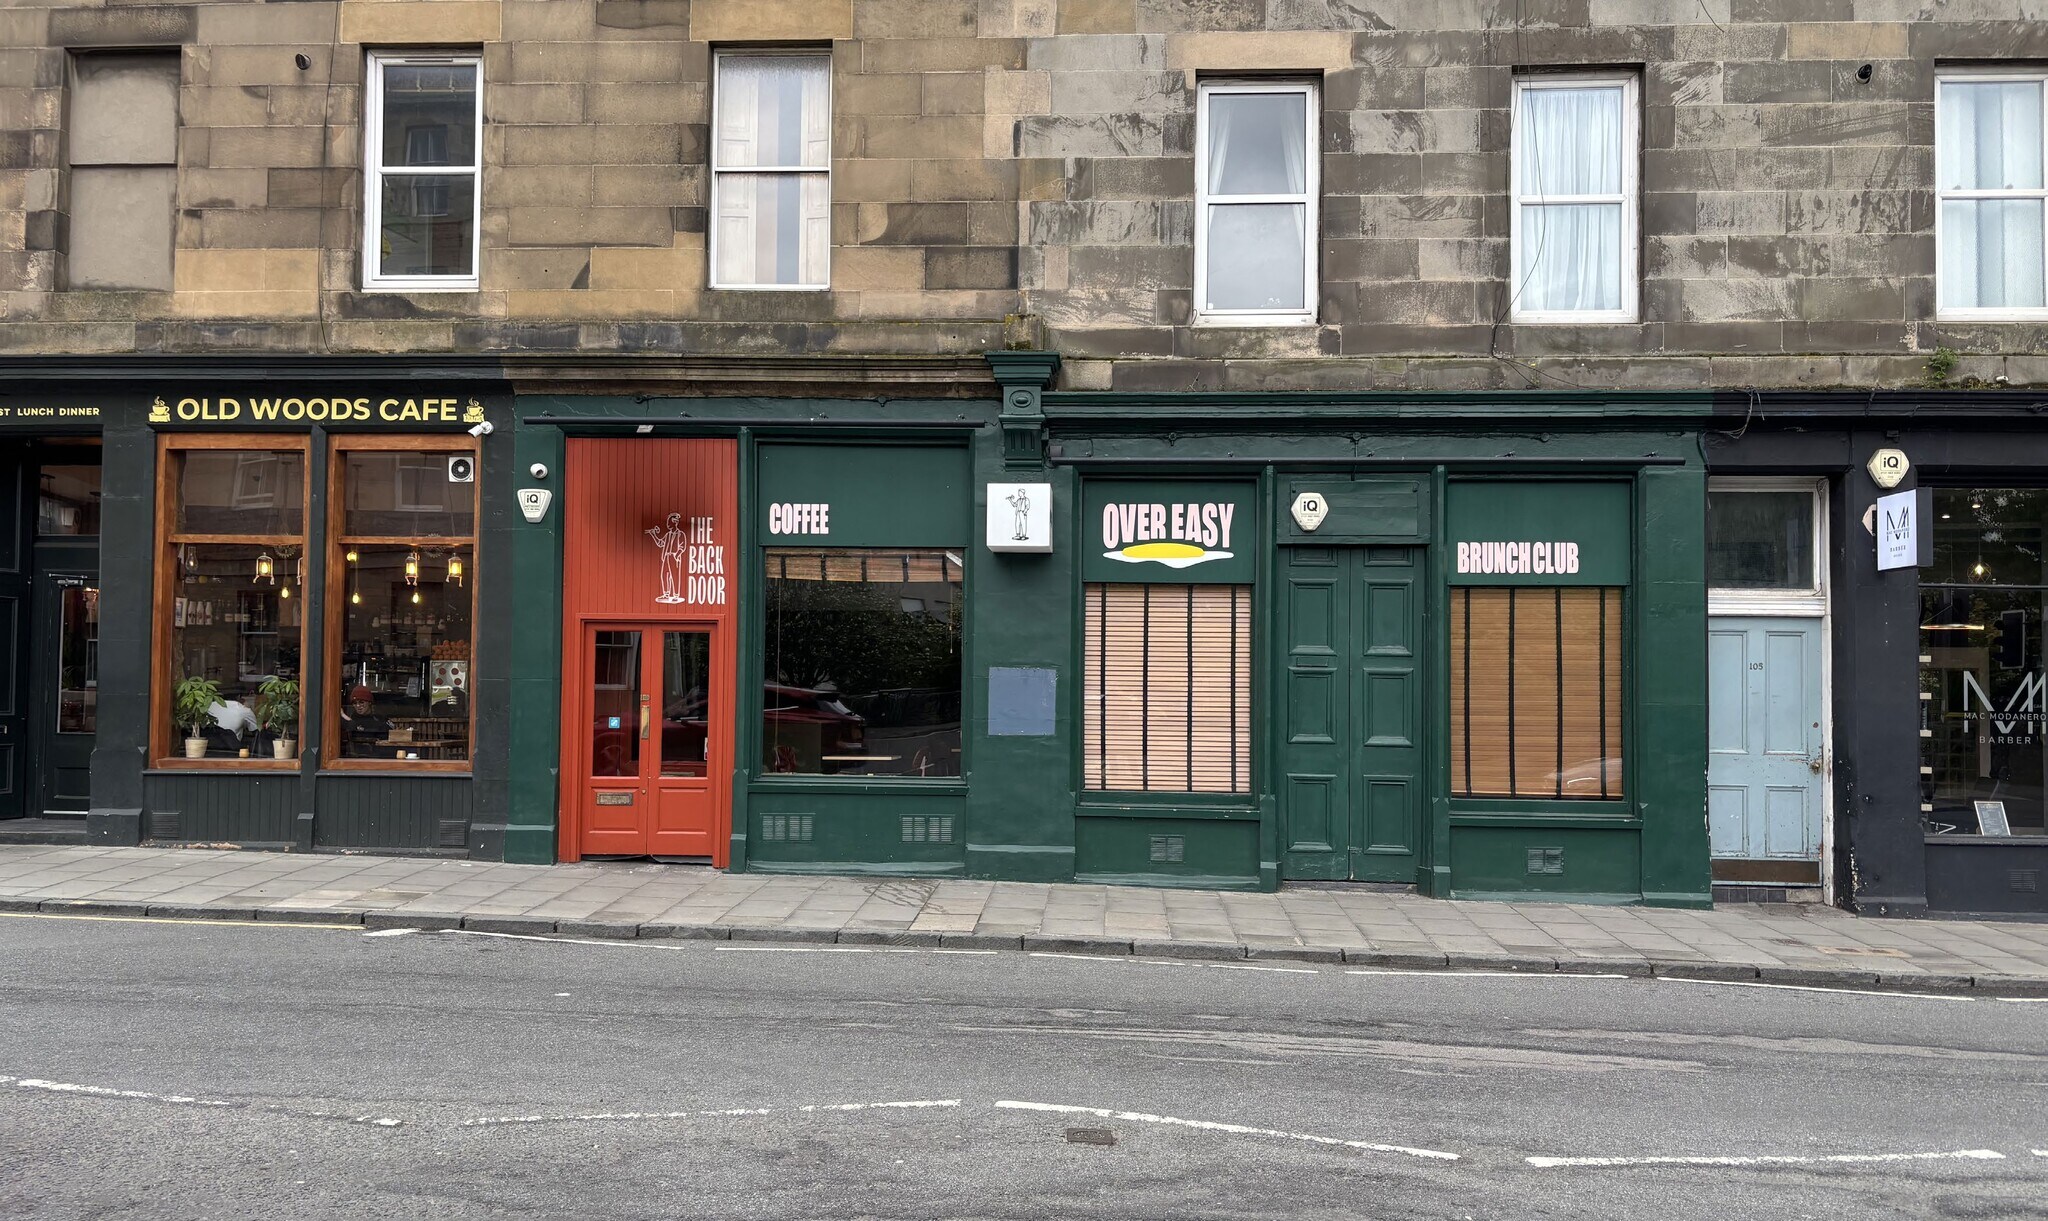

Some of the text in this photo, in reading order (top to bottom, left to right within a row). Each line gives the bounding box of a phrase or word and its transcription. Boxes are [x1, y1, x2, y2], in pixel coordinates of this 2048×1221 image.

[17, 408, 54, 416] LUNCH
[59, 408, 100, 416] DINNER
[177, 398, 458, 421] OLD WOODS CAFE
[1303, 500, 1318, 512] iQ
[690, 517, 714, 544] THE
[769, 503, 829, 535] COFFEE
[1103, 503, 1235, 549] OVER EASY
[689, 545, 725, 574] BACK
[1457, 541, 1579, 574] BRUNCH CLUB
[688, 575, 726, 605] DOOR
[1749, 662, 1764, 671] 105
[1963, 712, 2047, 721] MAC MODANERO
[1979, 735, 2032, 745] BARBER
